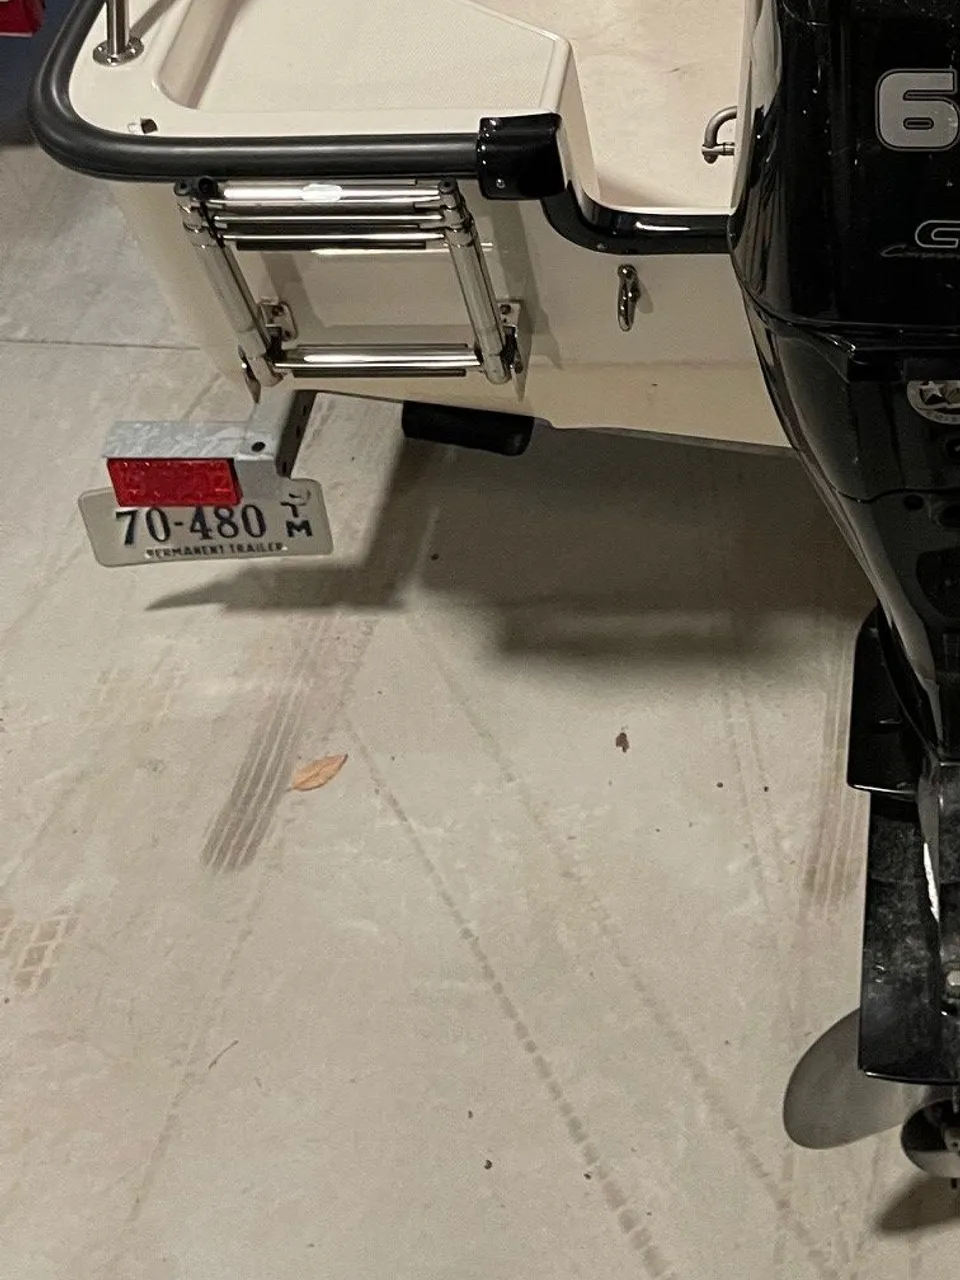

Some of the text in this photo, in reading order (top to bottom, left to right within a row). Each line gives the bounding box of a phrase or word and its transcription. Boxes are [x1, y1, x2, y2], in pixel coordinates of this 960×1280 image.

[115, 504, 267, 547] 70-480
[145, 541, 284, 560] PERMANENT TRAILER
